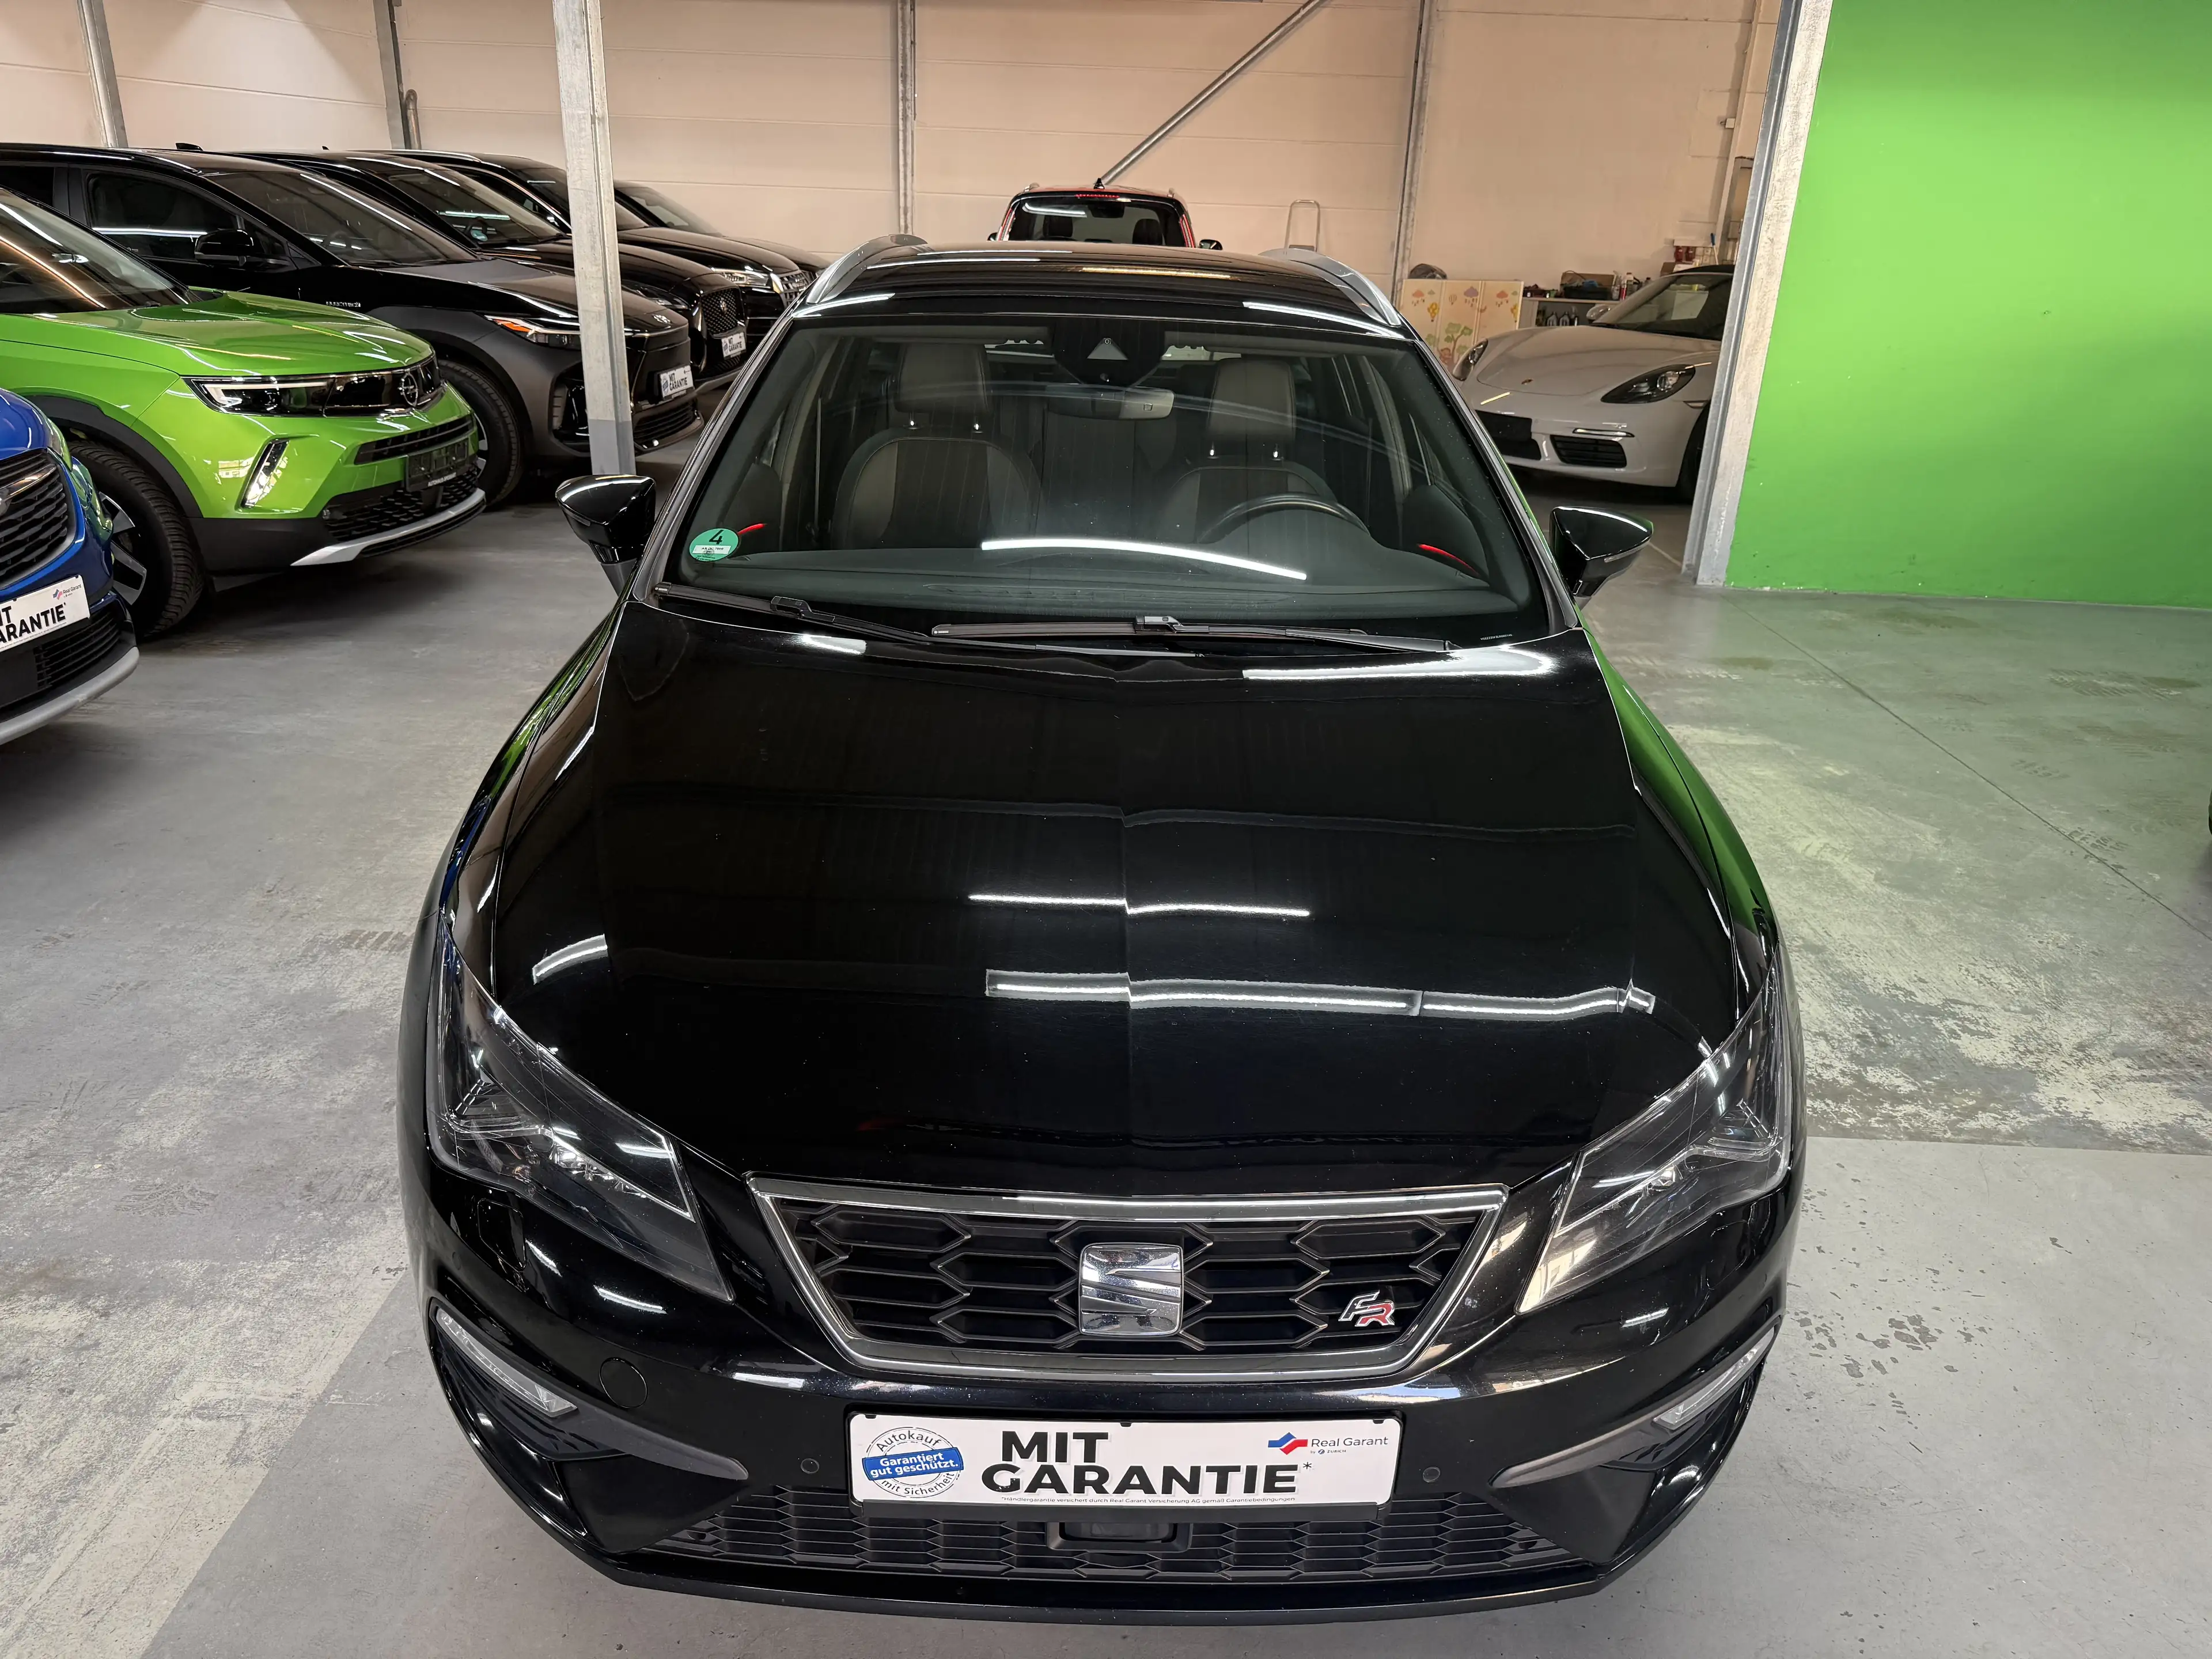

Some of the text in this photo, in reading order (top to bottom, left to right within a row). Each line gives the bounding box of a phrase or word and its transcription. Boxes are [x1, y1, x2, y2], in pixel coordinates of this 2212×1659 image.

[709, 529, 724, 545] 4
[0, 605, 12, 626] IT
[0, 602, 66, 643] ARANTIE
[1338, 1290, 1395, 1327] FR
[876, 1430, 942, 1452] Autokauf
[1002, 1431, 1109, 1463] MIT
[1311, 1437, 1388, 1447] Real Garant
[870, 1459, 959, 1478] gut geschützt.
[880, 1452, 944, 1467] Garantiert
[881, 1472, 955, 1495] mit Sicherheit
